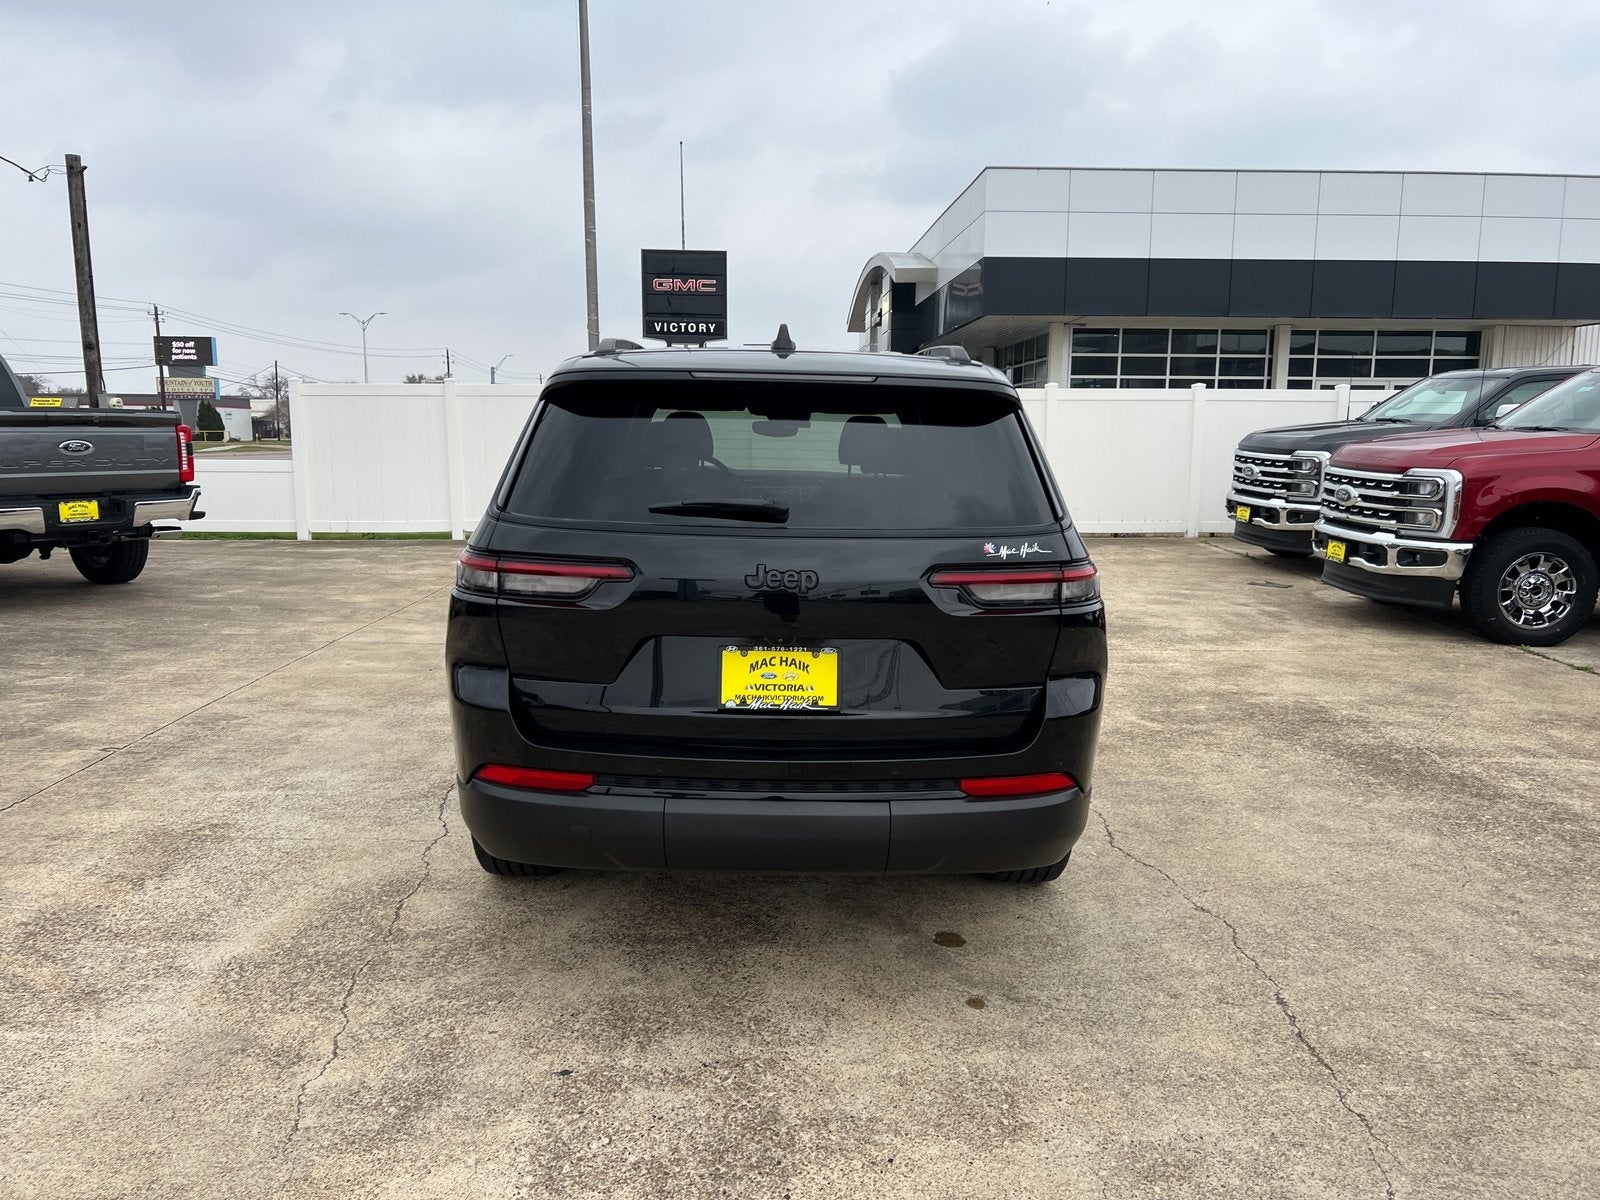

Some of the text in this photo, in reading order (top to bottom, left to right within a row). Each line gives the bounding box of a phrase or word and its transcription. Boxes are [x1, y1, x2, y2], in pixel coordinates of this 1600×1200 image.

[652, 278, 717, 292] GMC
[654, 322, 716, 333] VICTORY
[194, 380, 213, 388] YOUTH
[67, 442, 86, 451] Ford
[994, 542, 1050, 560] Mac Haik
[745, 564, 819, 594] Jeep
[749, 656, 810, 674] MAC HAIK
[754, 683, 805, 692] VICTORIA
[745, 697, 822, 710] Mac Haik
